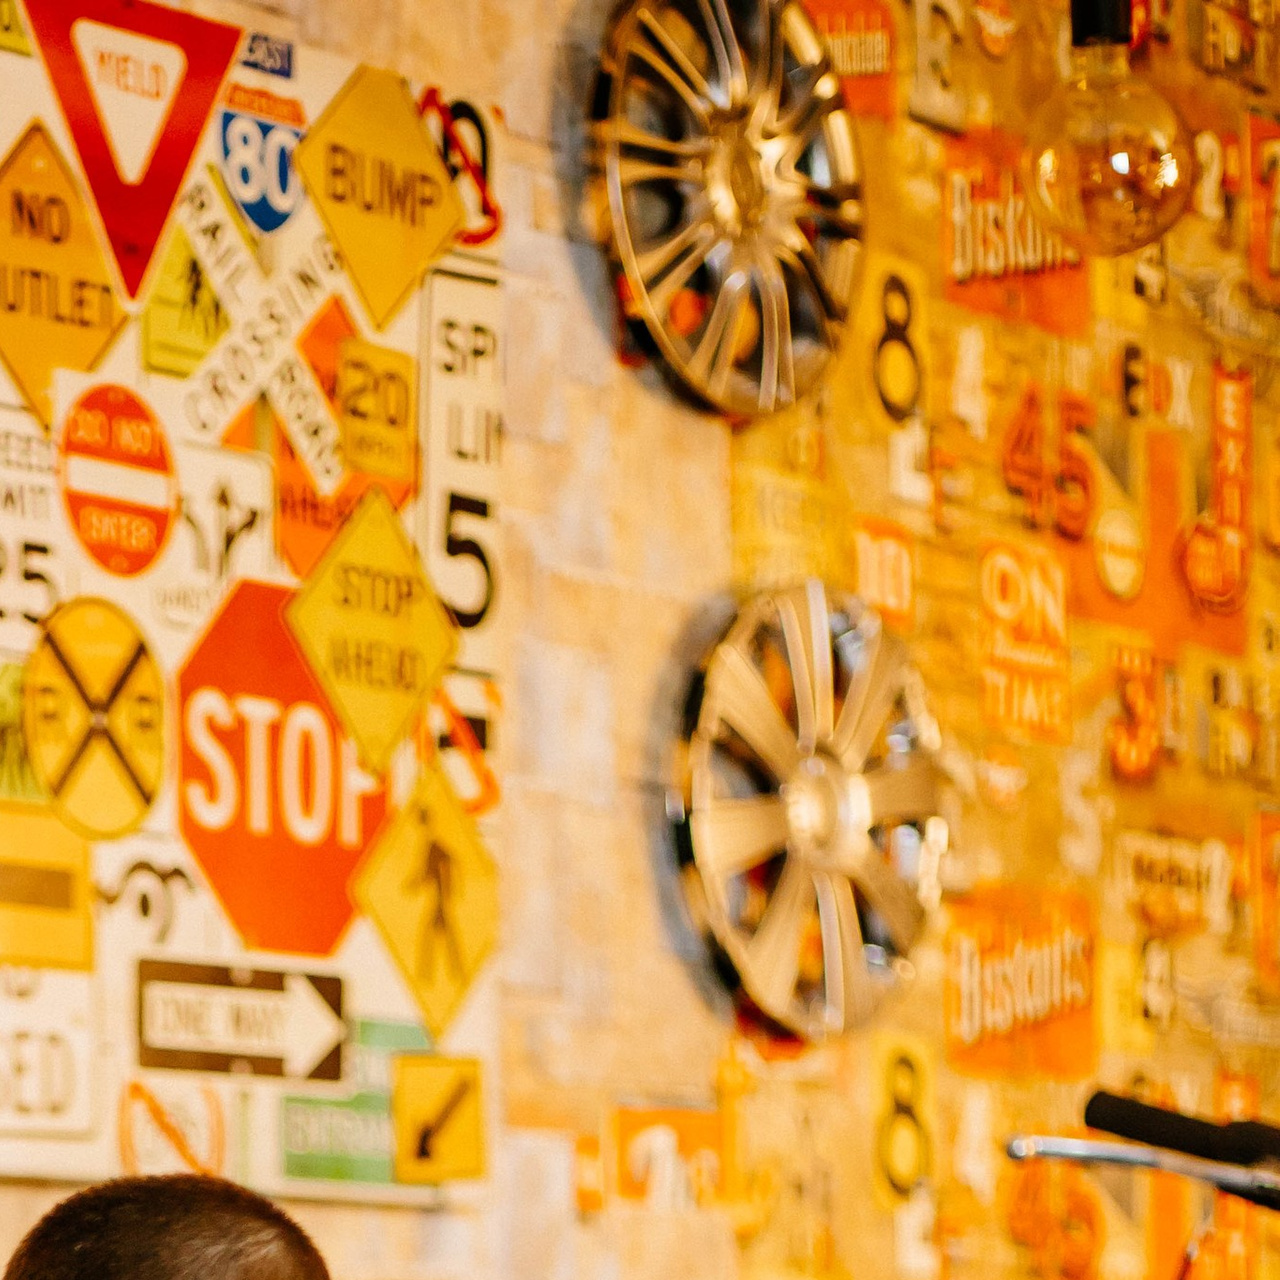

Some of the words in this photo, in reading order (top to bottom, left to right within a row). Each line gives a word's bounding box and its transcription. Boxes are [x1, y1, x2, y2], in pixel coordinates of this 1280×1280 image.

[224, 115, 304, 214] 80
[325, 143, 443, 229] BUMP
[11, 188, 70, 244] NO
[875, 273, 920, 422] 8
